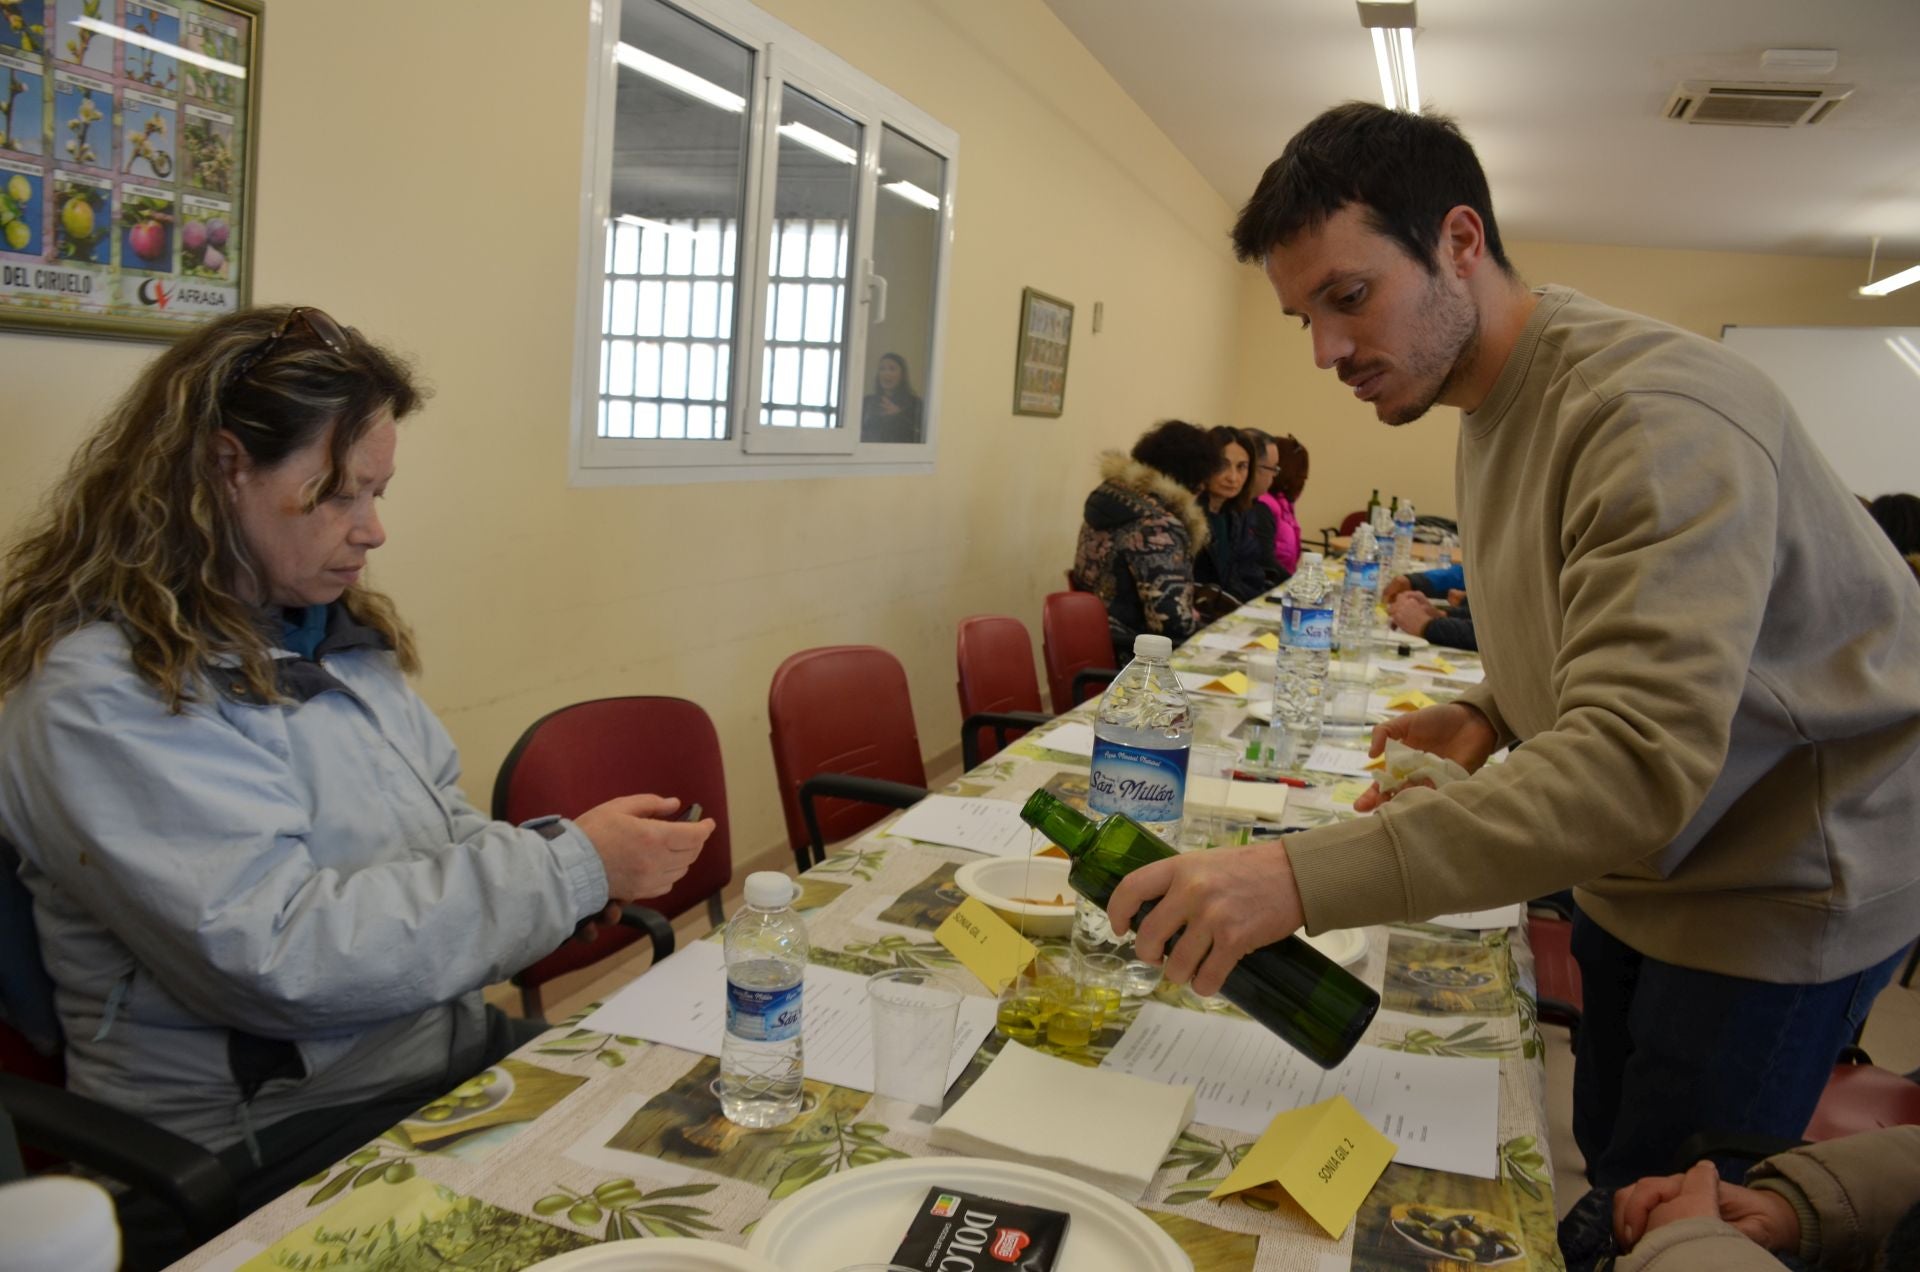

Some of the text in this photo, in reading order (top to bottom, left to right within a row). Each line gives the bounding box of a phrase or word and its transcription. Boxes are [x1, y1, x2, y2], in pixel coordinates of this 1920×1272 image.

[3, 265, 92, 294] DEL CIRUELO
[177, 288, 226, 306] AFRASA
[1091, 771, 1175, 801] San Millán
[1318, 1138, 1355, 1183] SONIA GIL 2
